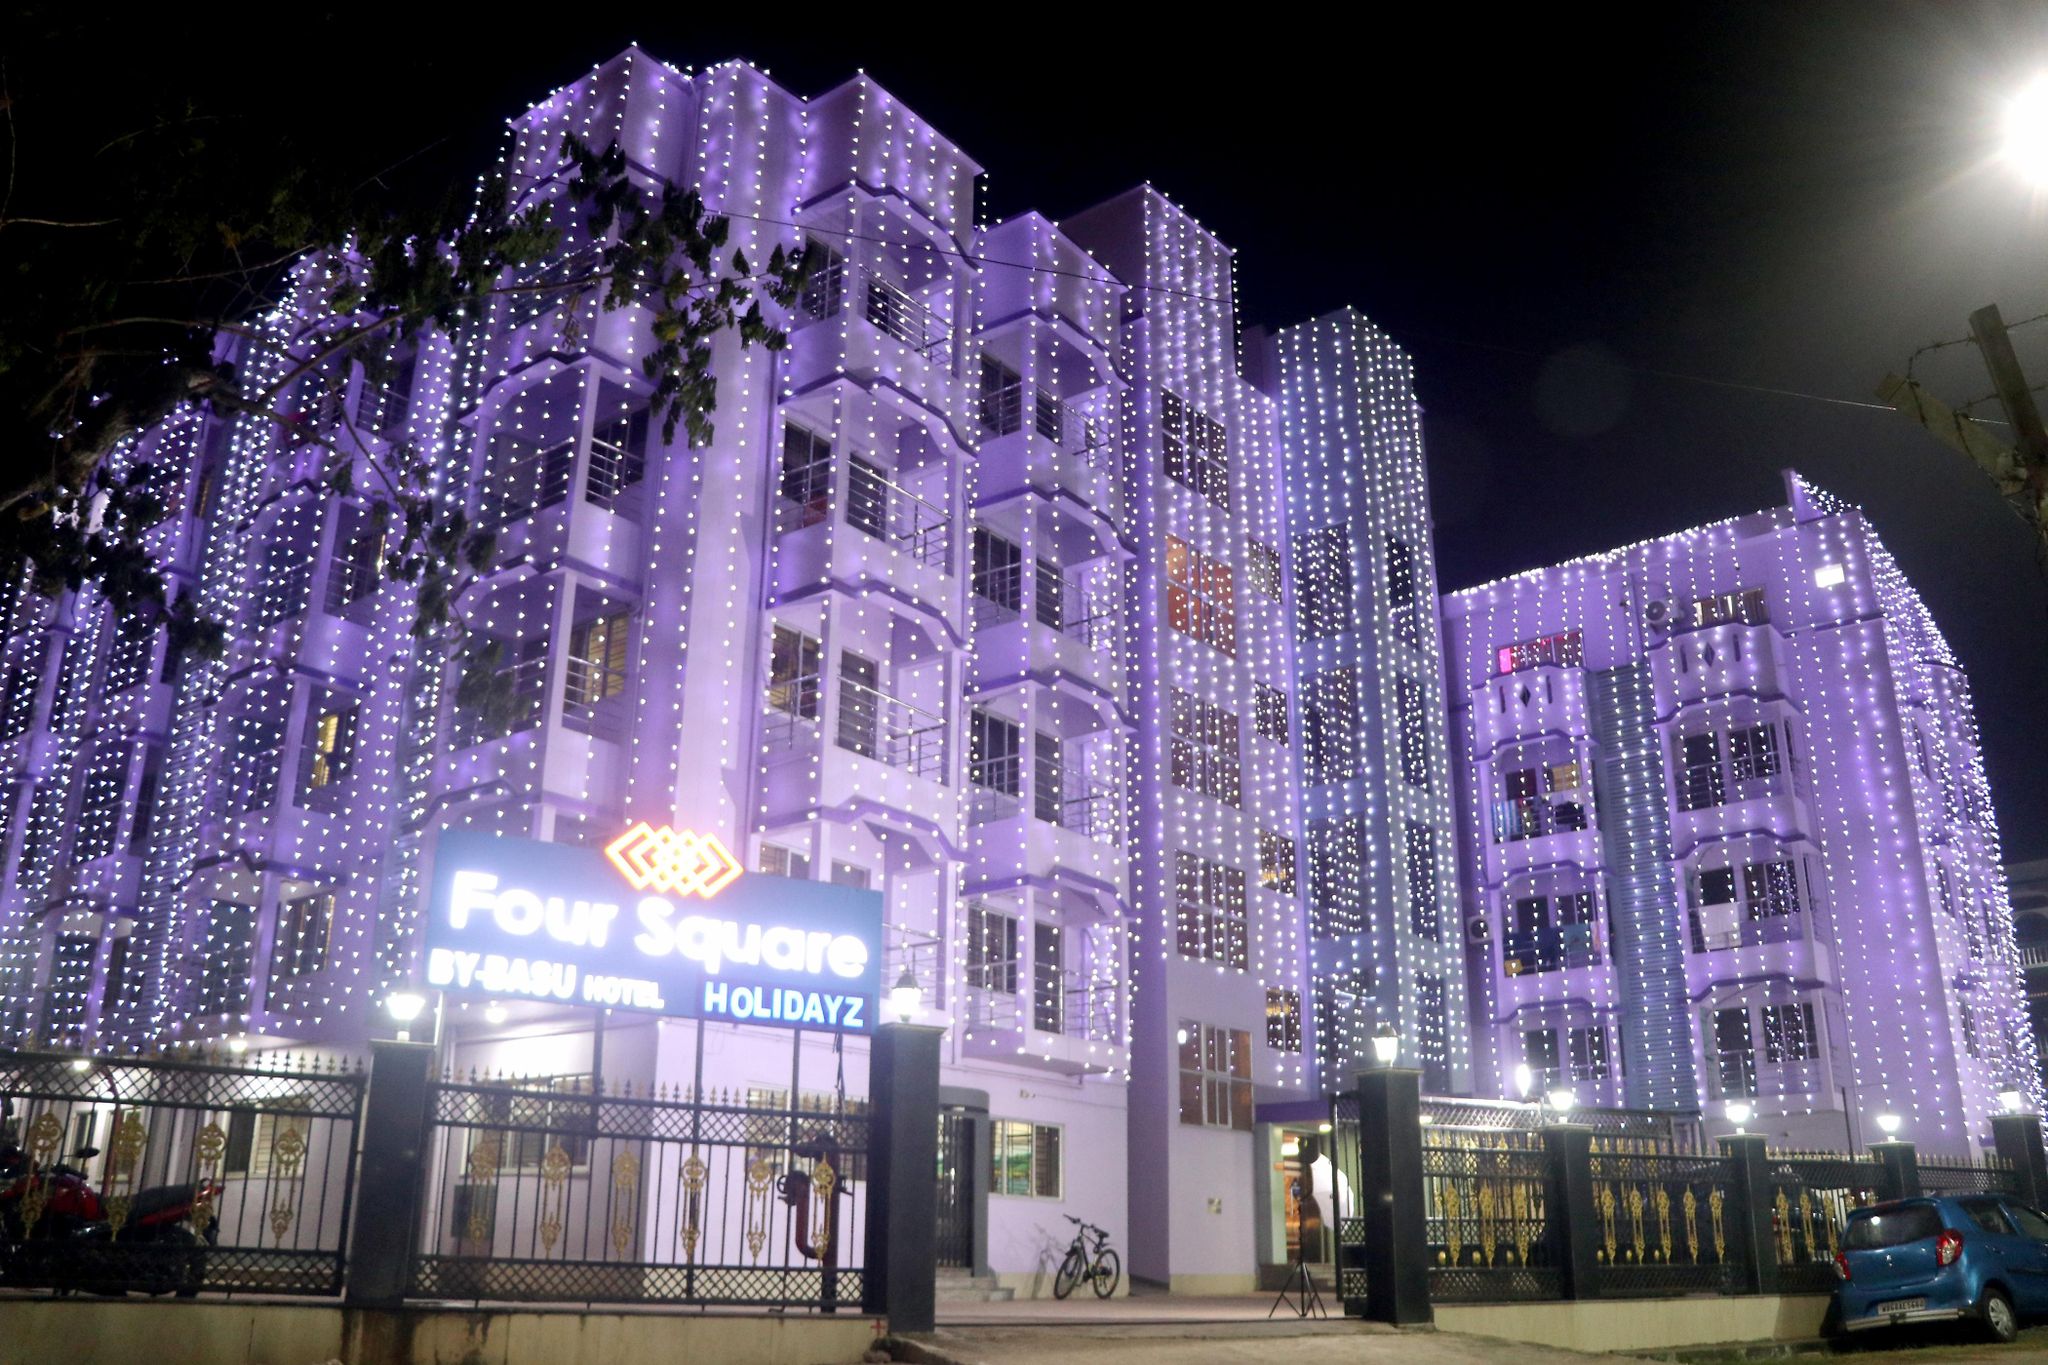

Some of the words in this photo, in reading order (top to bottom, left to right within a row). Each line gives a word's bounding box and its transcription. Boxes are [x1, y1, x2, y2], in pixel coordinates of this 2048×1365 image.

[449, 870, 619, 948] Four
[634, 896, 868, 978] Square
[584, 974, 665, 1009] HOTEL
[704, 981, 864, 1028] HOLIDAYZ
